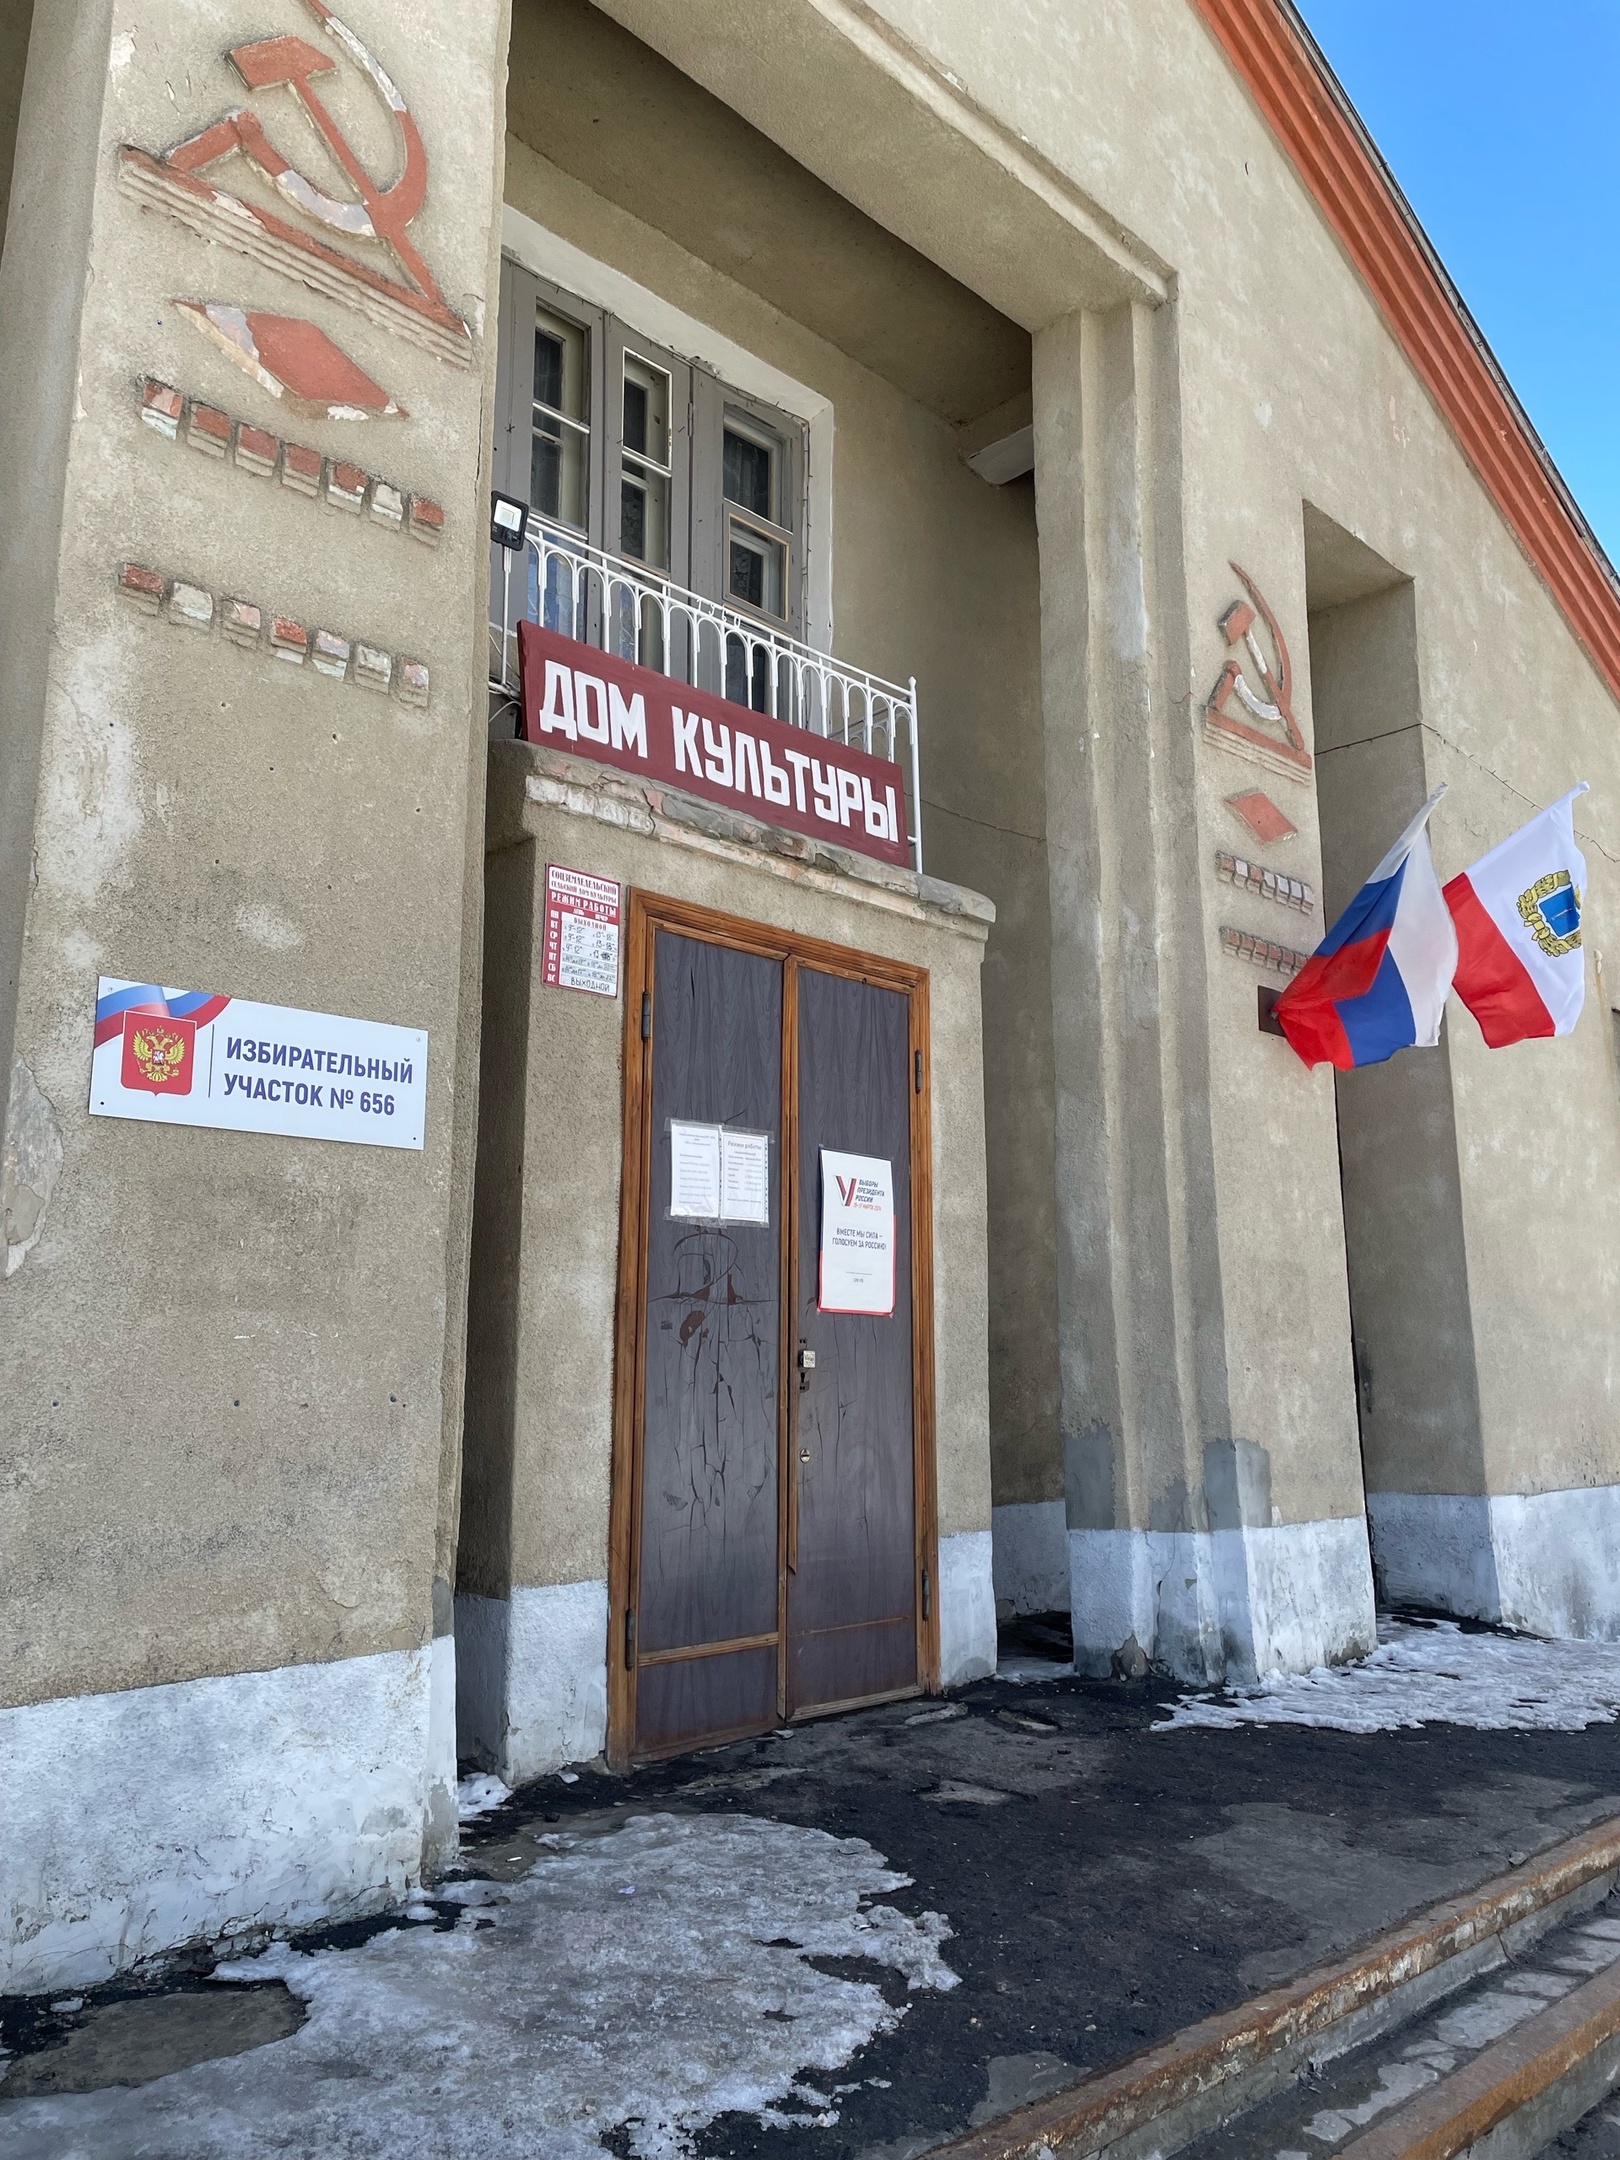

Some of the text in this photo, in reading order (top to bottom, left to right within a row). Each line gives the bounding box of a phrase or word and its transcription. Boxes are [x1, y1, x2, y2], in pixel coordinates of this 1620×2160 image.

[539, 659, 899, 844] ДОМ КУЛЬТУРЫ
[551, 881, 617, 904] СЕЛЬСКИЙ ДОМ КУЛЬТУРЫ
[551, 891, 616, 917] РЕЖИМ РАБОТЫ
[550, 909, 607, 931] ПН ВЫХОДНОЙ
[550, 920, 559, 929] ВТ
[549, 930, 558, 939] СР
[549, 941, 557, 951] ЧТ
[548, 952, 557, 961] ПТ
[547, 962, 556, 972] СБ
[547, 973, 556, 982] ВС
[226, 1036, 413, 1084] ИЗБИРАТЕЛЬНЫЙ
[224, 1073, 395, 1116] УЧАСТОК № 656
[859, 1179, 879, 1188] ВЫБОРЫ
[857, 1187, 885, 1197] ПРЕЗИДЕНТА
[855, 1194, 874, 1203] РОССИИ
[836, 1227, 856, 1237] ВМЕСТЕ
[856, 1230, 865, 1238] МЫ
[866, 1231, 879, 1239] СИЛА
[832, 1237, 887, 1250] ГОЛОСУЕМ ЗА РОССИЮ!
